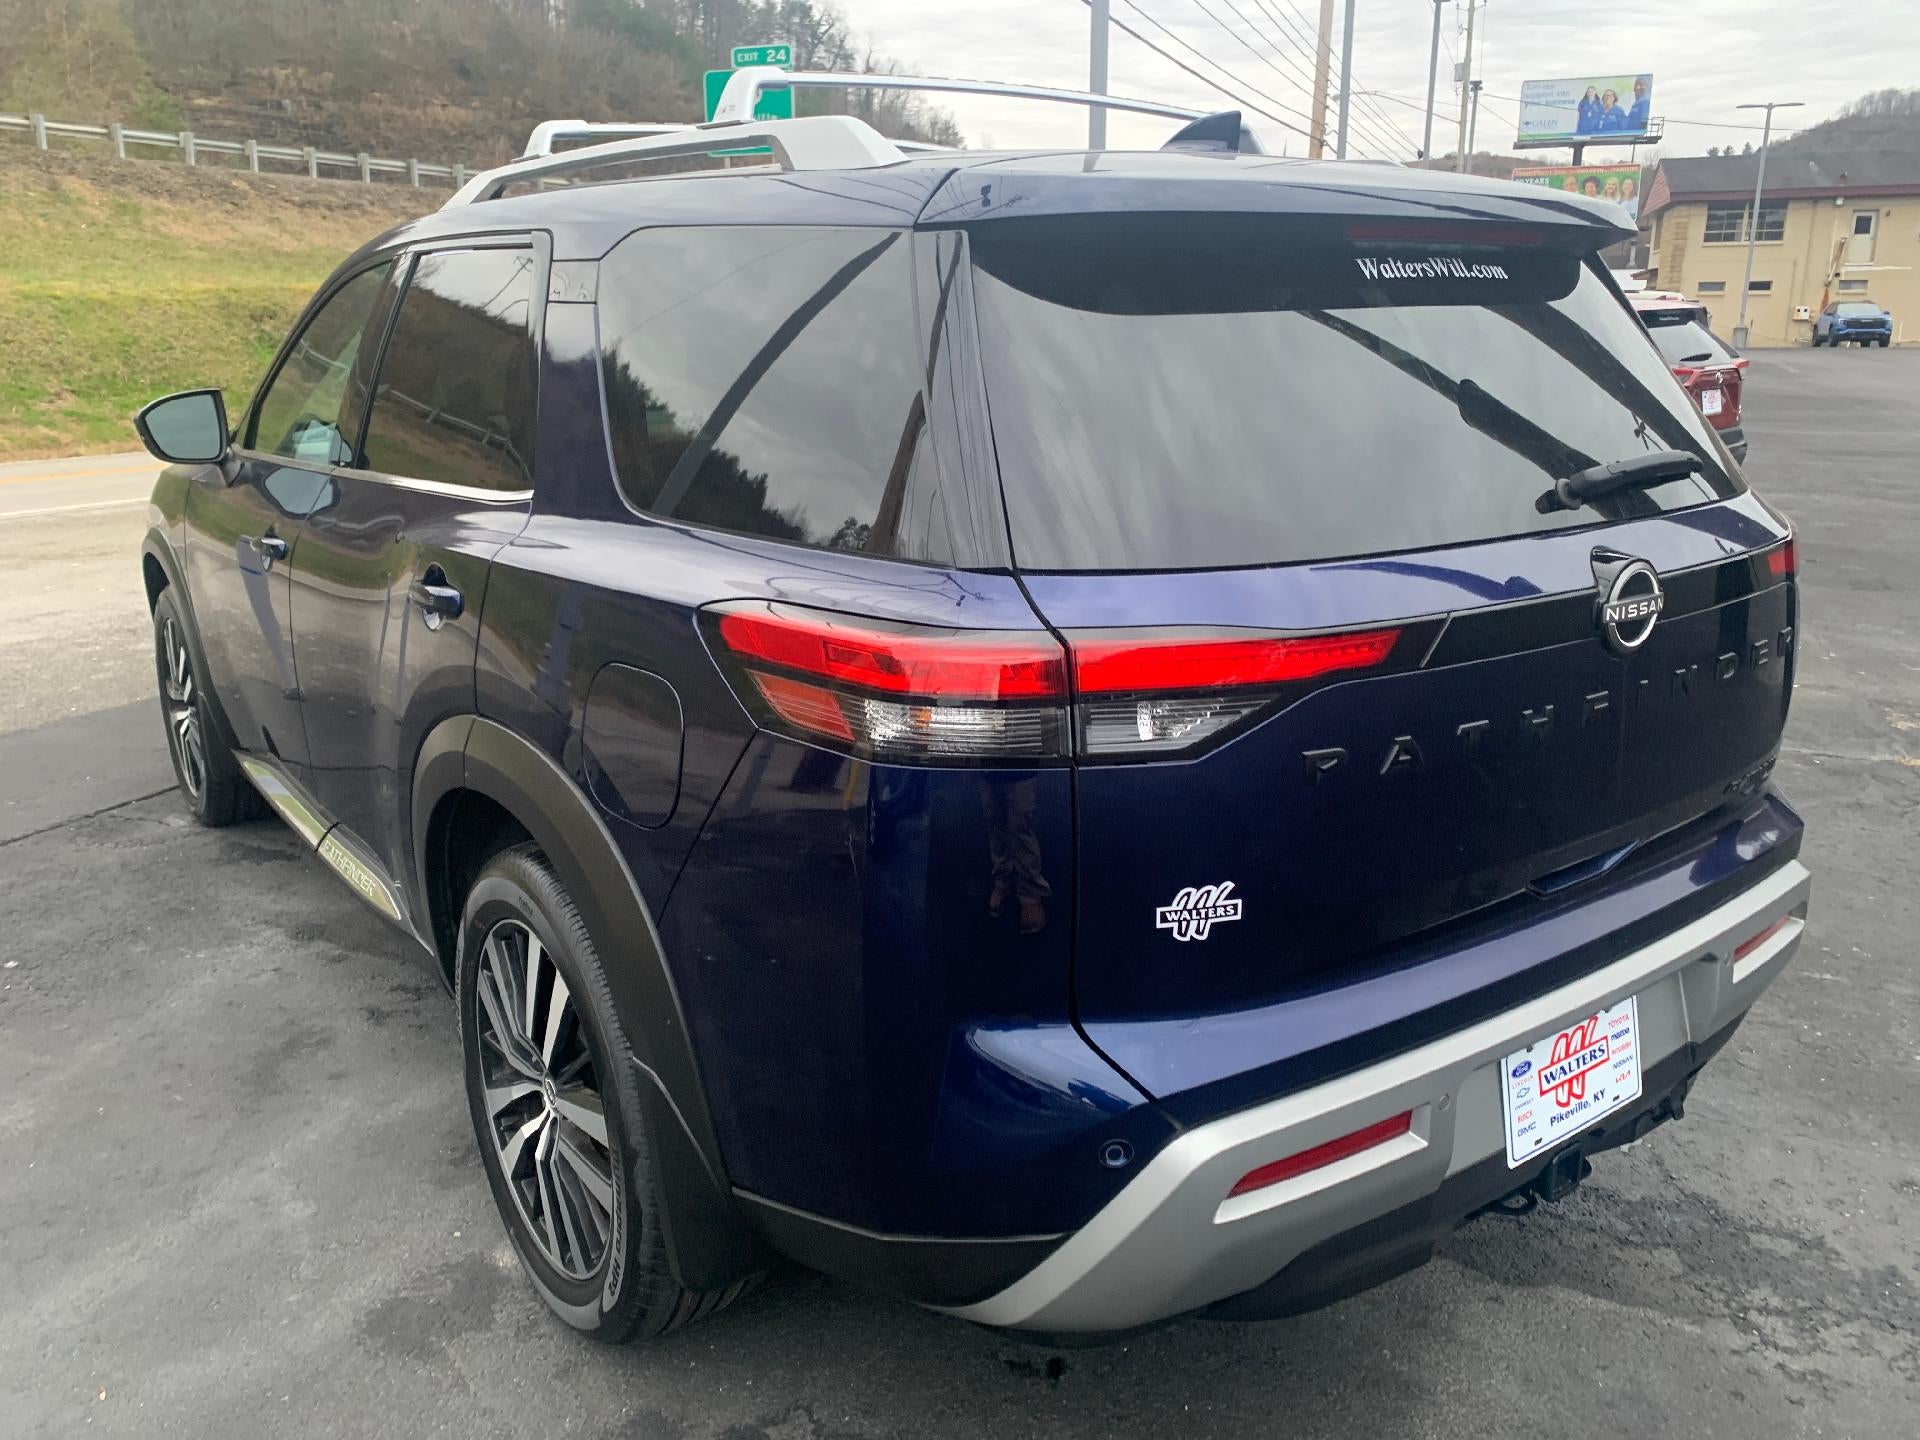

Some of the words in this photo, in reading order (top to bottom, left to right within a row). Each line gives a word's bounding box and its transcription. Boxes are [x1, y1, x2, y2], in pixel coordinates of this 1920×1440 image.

[737, 52, 758, 62] EXIT
[766, 49, 787, 62] 24
[1355, 256, 1509, 280] WaltersWill.com
[1606, 598, 1664, 621] NISSAN
[1301, 626, 1795, 786] PATHFINDER
[1165, 905, 1235, 922] WALTERS
[1608, 1013, 1630, 1029] TOYOTA
[1514, 1062, 1530, 1077] Ford
[1543, 1044, 1606, 1085] WALTERS
[1613, 1055, 1634, 1070] NISSAN
[1550, 1098, 1592, 1127] Pikeville,
[1593, 1088, 1606, 1103] KY
[1517, 1121, 1537, 1138] GMC
